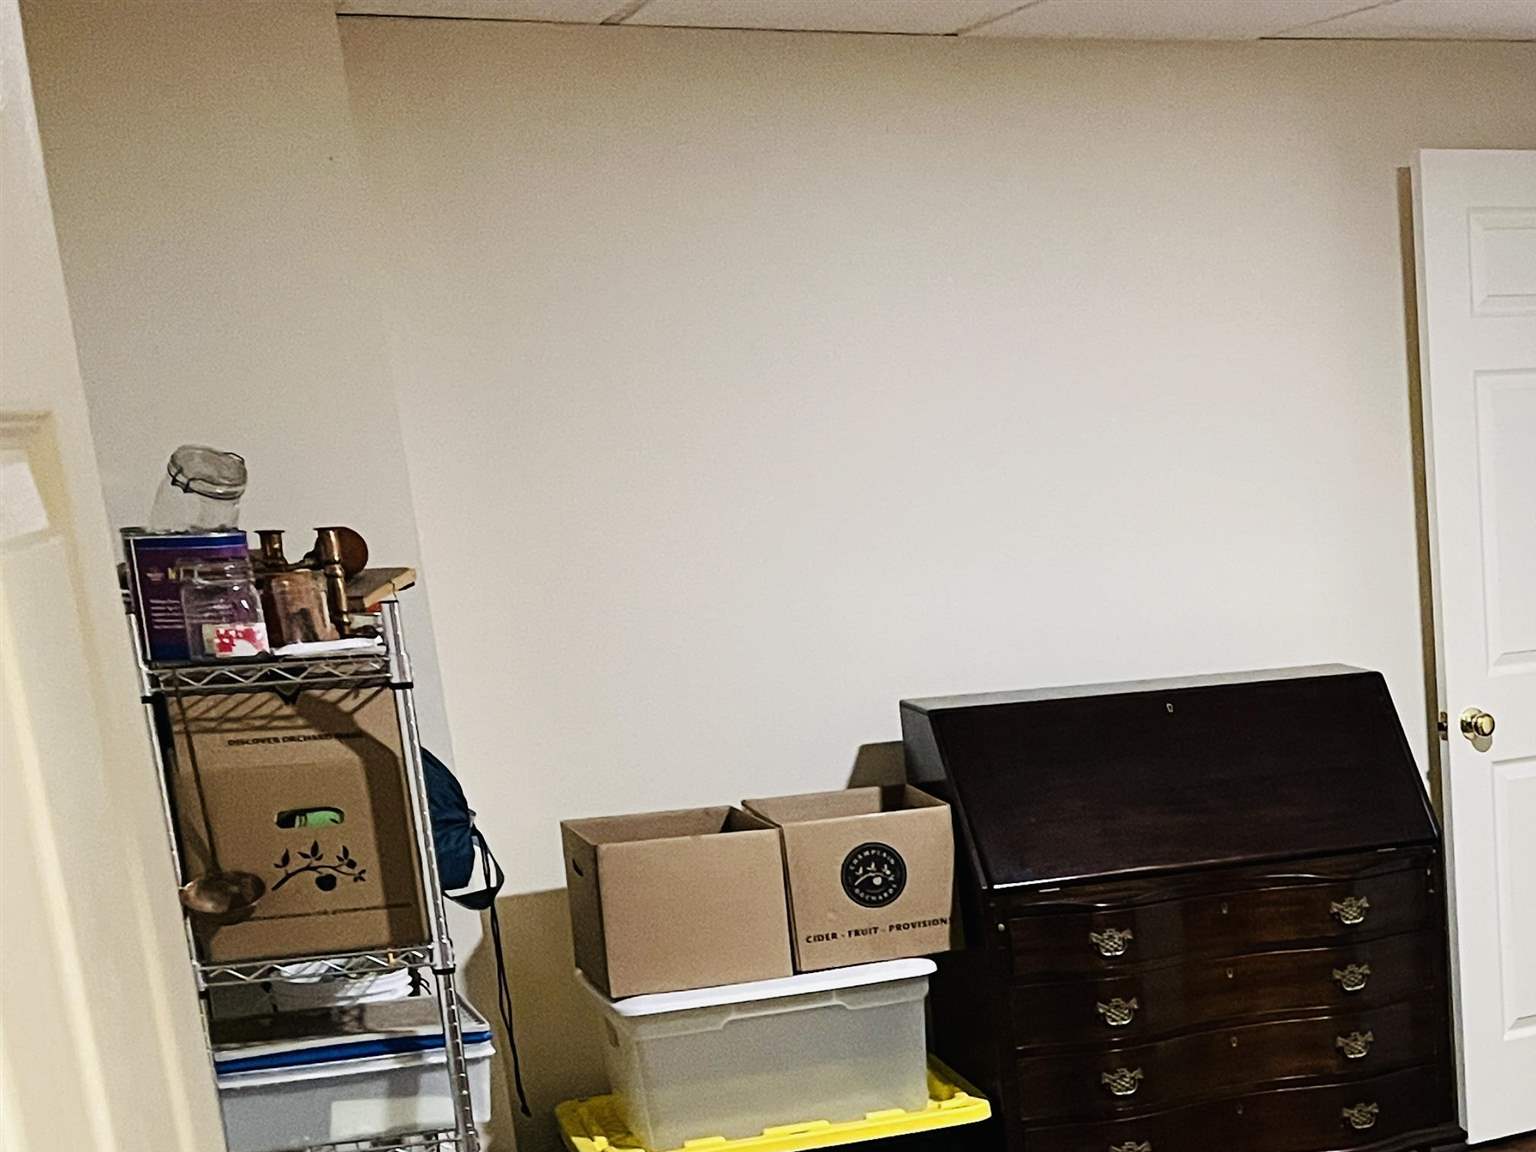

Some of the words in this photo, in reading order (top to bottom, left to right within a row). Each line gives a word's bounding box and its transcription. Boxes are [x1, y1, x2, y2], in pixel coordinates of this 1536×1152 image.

[849, 849, 895, 870] CHAMPLAIN
[805, 931, 838, 944] CIDER
[847, 926, 880, 938] FRUIT
